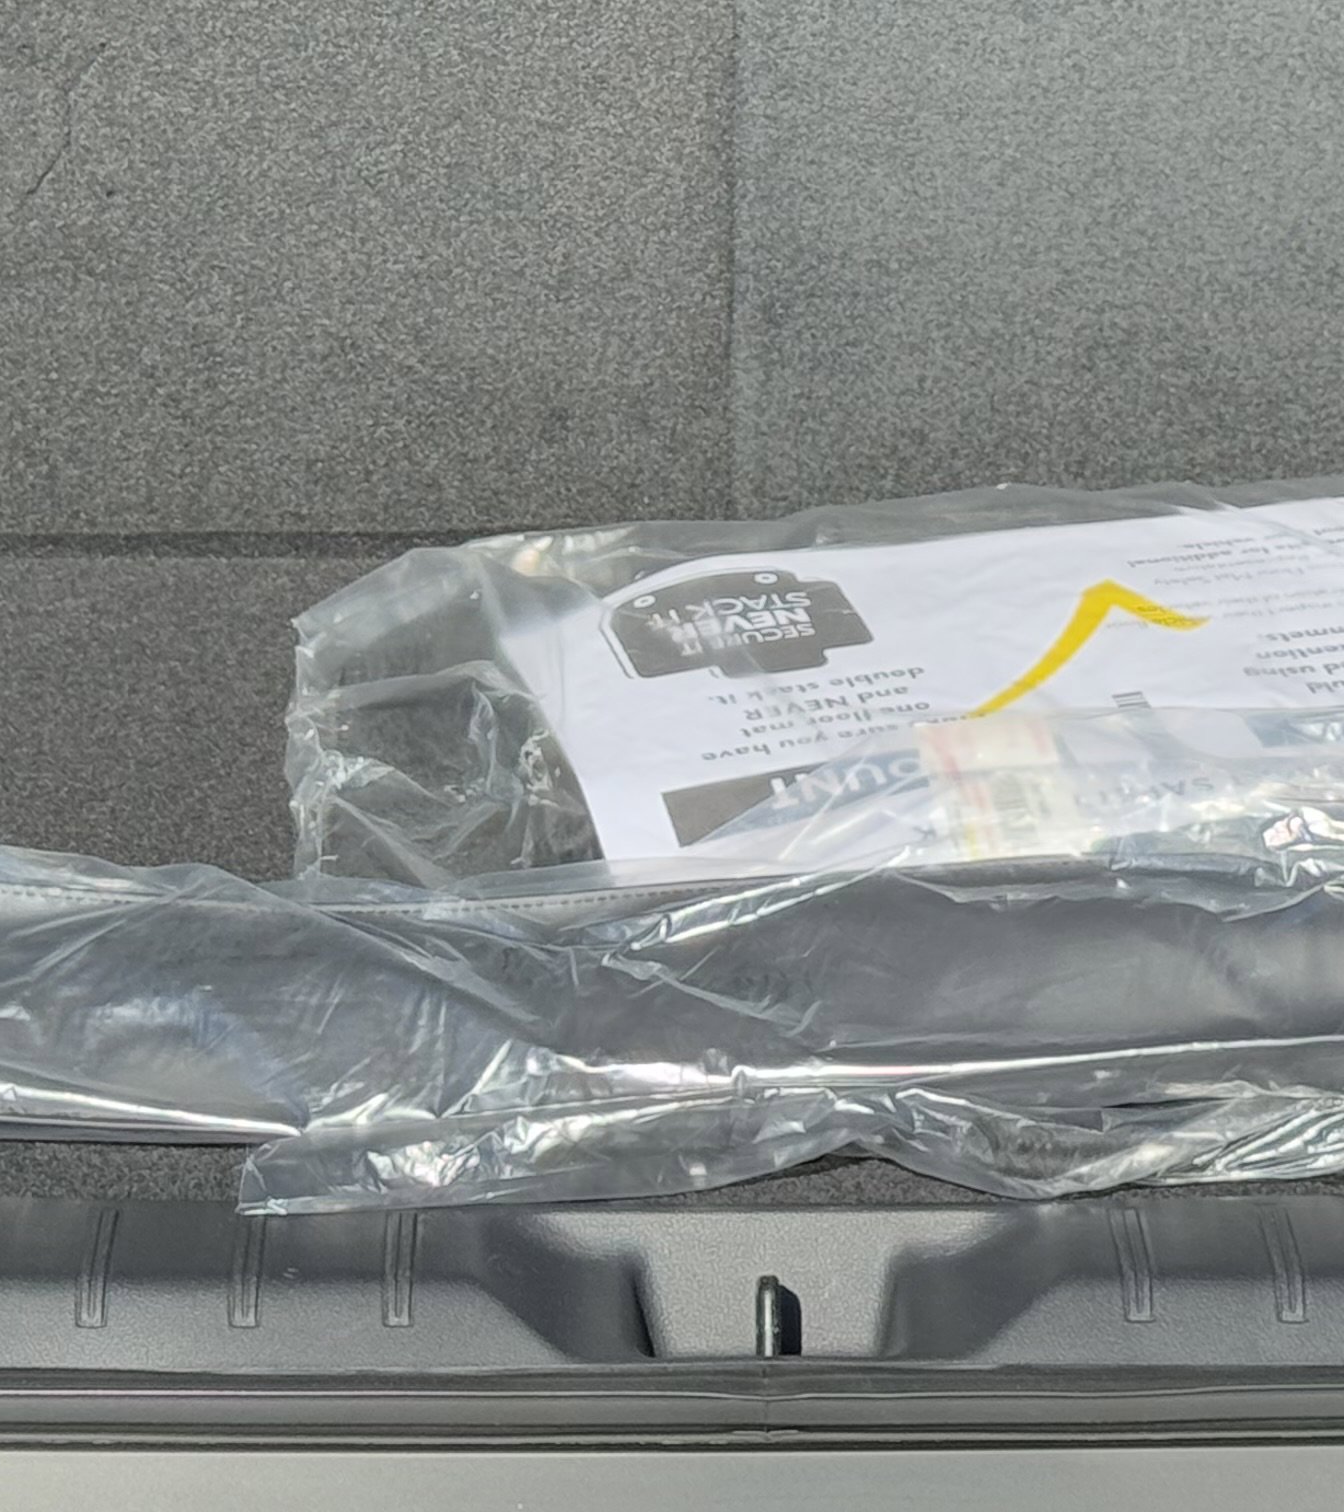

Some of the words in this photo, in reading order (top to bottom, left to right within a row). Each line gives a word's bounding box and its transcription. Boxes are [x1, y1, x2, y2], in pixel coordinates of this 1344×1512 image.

[685, 591, 812, 620] STACK
[670, 607, 812, 643] NEVER
[828, 667, 925, 688] double
[1243, 665, 1316, 677] using
[857, 686, 909, 704] and
[743, 695, 850, 721] NEVER
[879, 702, 930, 714] one
[806, 709, 872, 726] floor
[739, 720, 794, 738] mat
[837, 724, 899, 739] sure
[778, 730, 829, 748] you
[700, 743, 771, 762] have
[771, 759, 920, 810] OUNT
